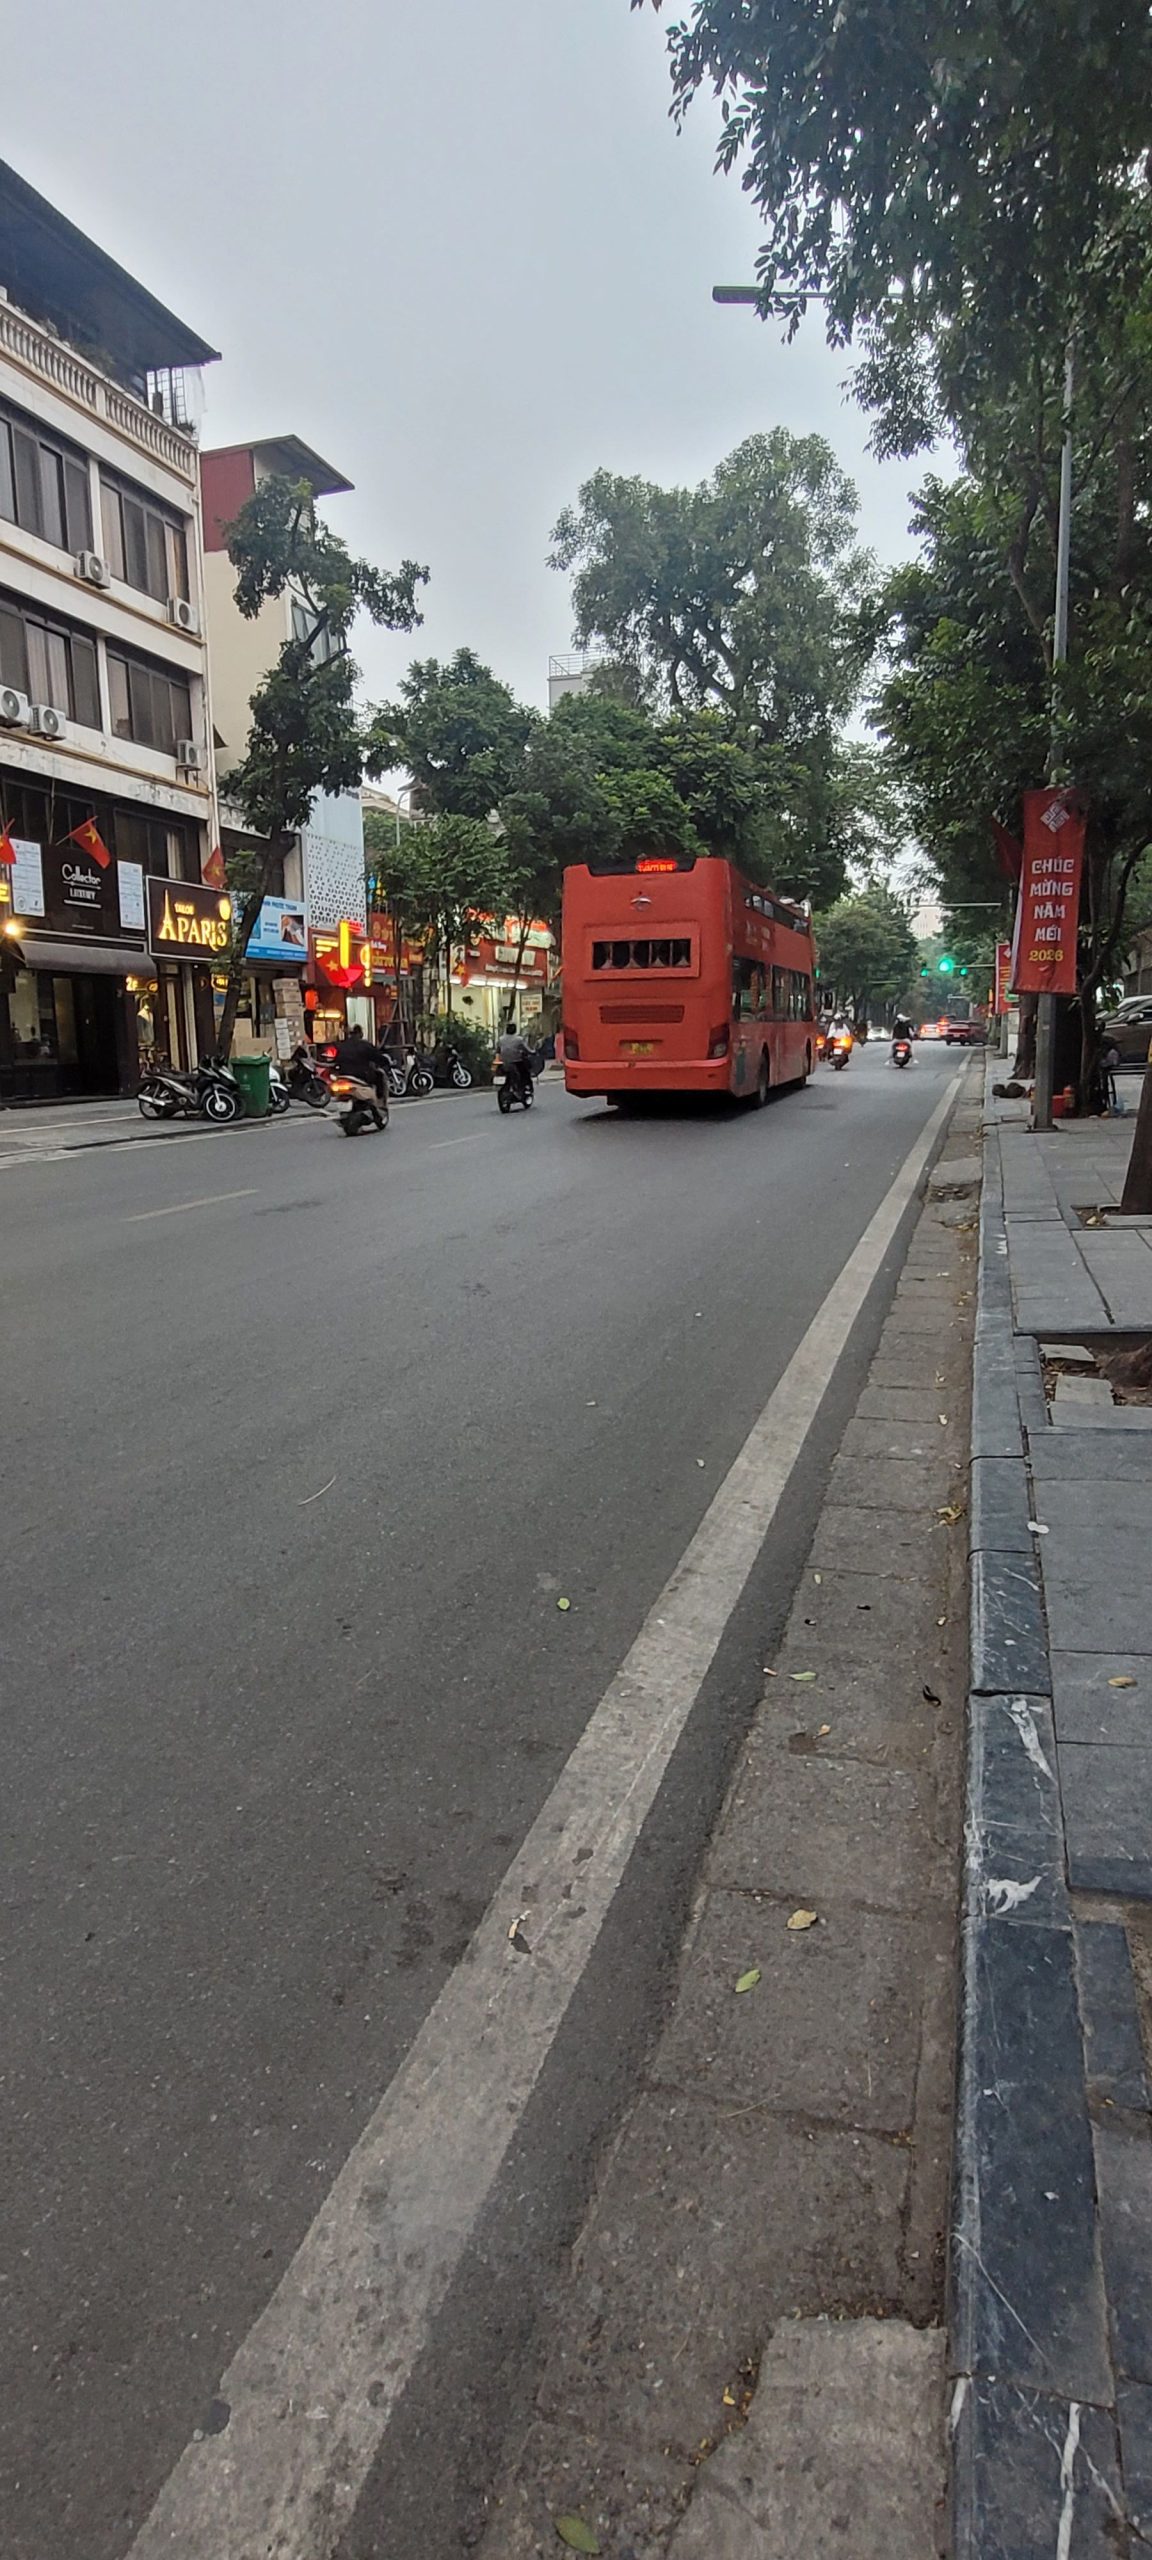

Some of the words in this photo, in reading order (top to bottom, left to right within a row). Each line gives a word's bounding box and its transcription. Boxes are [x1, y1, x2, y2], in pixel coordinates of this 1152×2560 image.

[1031, 857, 1074, 874] CHÚC
[1030, 880, 1073, 897] MỪNG
[1033, 902, 1065, 919] NĂM
[1034, 925, 1061, 942] MỚI
[1028, 950, 1063, 962] 2026
